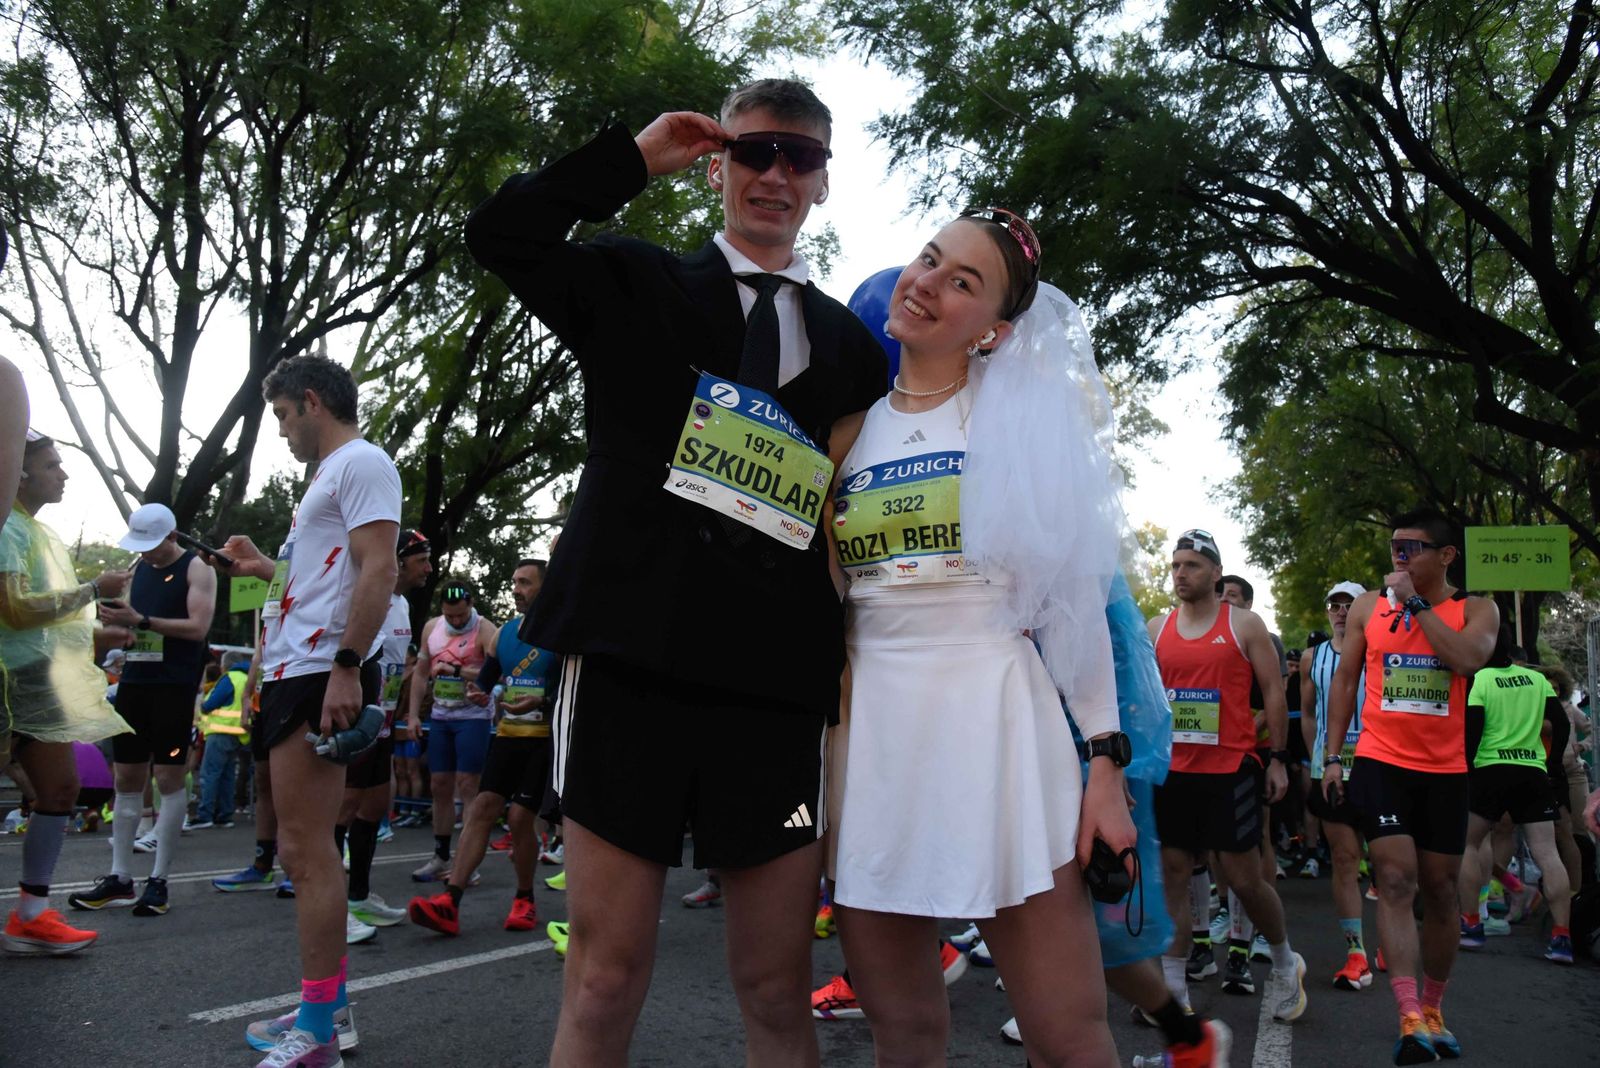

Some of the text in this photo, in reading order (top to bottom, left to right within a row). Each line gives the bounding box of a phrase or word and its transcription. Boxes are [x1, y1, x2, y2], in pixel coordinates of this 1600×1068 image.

[748, 400, 816, 448] ZURICH
[745, 433, 785, 463] 1974
[882, 458, 963, 481] ZURICH
[680, 436, 820, 520] SZKUDLAR
[882, 494, 925, 516] 3322
[838, 532, 889, 563] ROZI
[1481, 553, 1498, 564] 2h
[1535, 553, 1552, 564] 3h
[1407, 674, 1427, 683] 1513
[1494, 675, 1534, 688] OLVERA
[1178, 691, 1213, 700] ZURICH
[1383, 686, 1450, 702] ALEJANDRO
[1174, 718, 1202, 730] MICK
[1497, 749, 1537, 760] RIVERA
